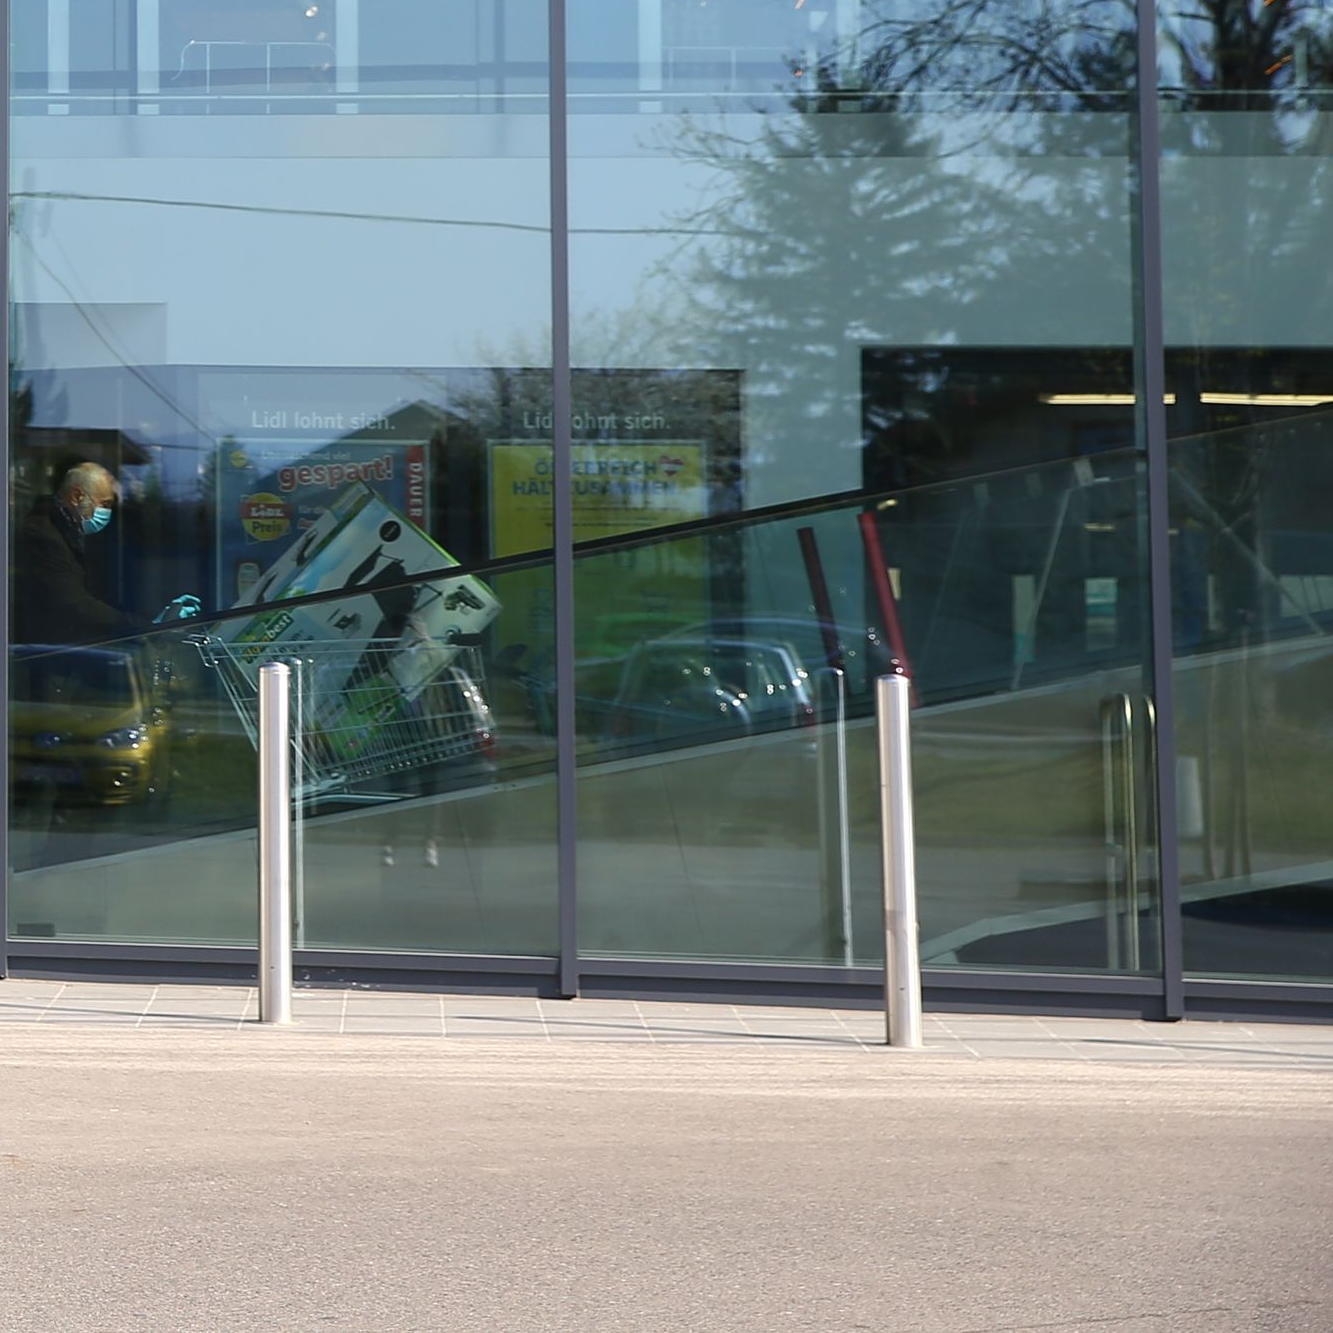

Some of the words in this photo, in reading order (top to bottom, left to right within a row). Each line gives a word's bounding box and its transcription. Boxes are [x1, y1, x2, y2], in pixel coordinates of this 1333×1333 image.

[252, 411, 286, 429] Lidl
[295, 411, 344, 430] lohnt
[350, 411, 396, 430] sich.
[523, 411, 553, 429] Lid
[572, 411, 617, 430] ohnt
[624, 411, 671, 430] sich.
[278, 454, 393, 492] gespart!
[534, 457, 656, 475] ÖERREICH
[410, 462, 423, 517] DAUER
[252, 520, 282, 533] Preis
